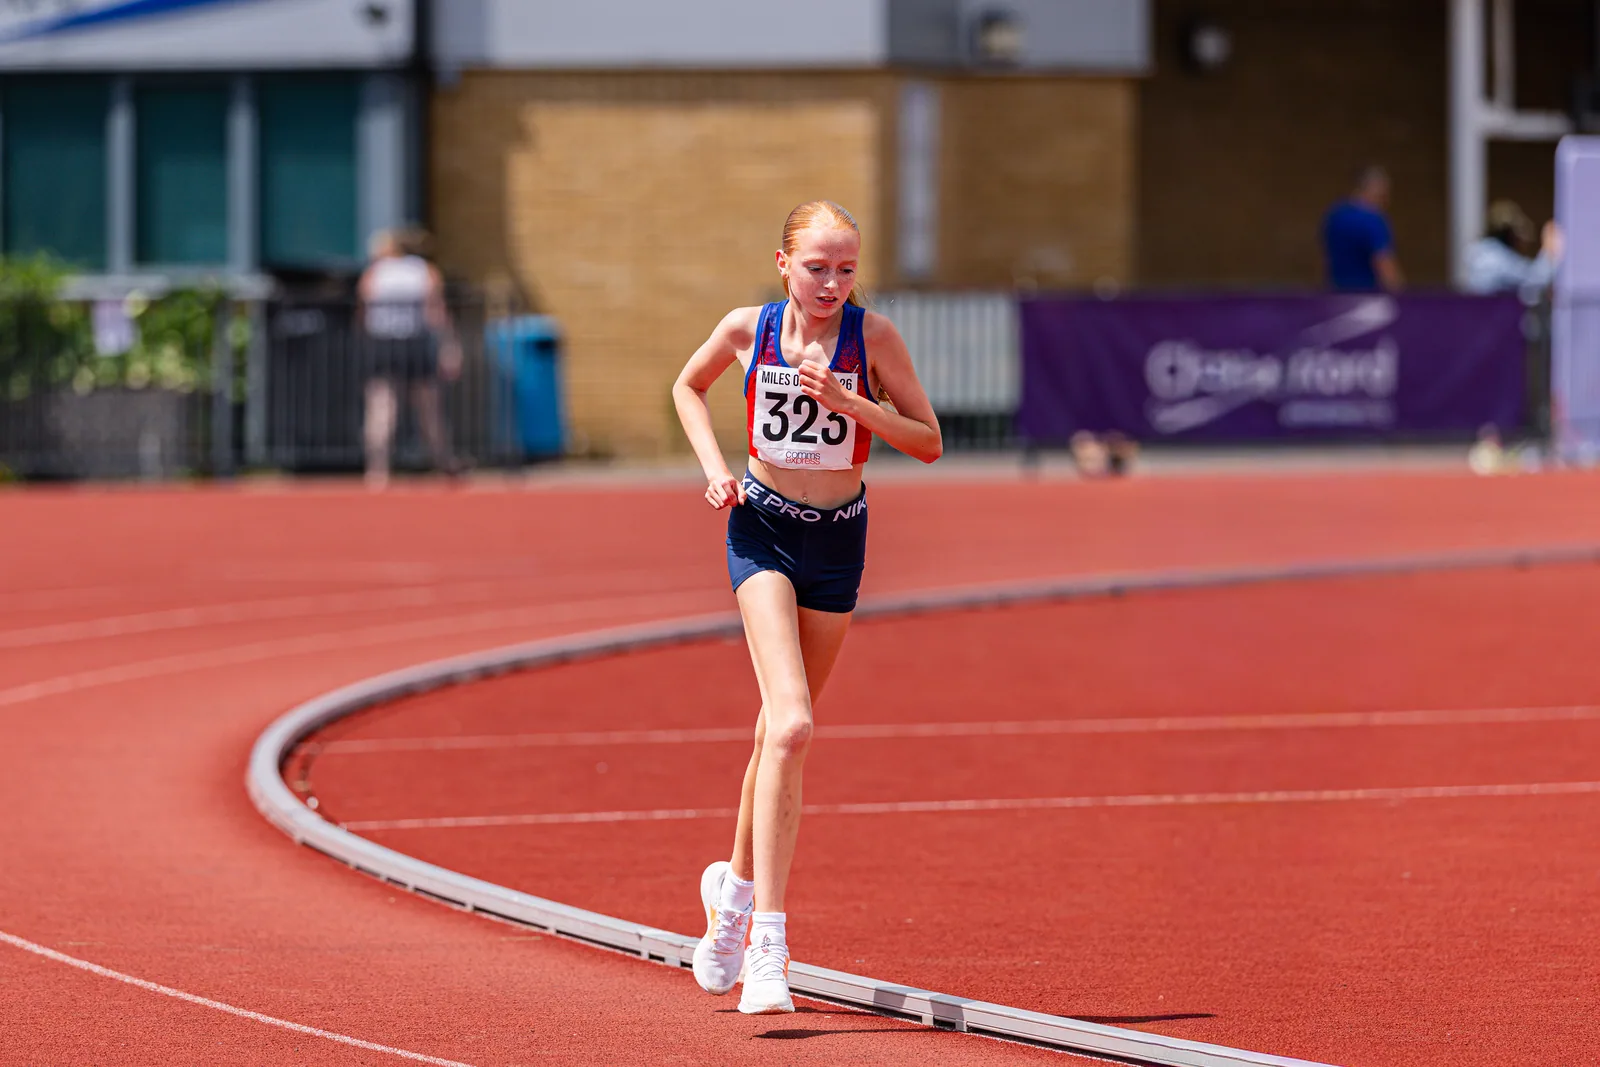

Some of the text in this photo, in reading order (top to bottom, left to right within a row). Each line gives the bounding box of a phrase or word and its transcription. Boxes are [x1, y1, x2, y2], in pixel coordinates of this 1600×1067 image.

[761, 370, 791, 386] MILES
[762, 391, 848, 446] 323
[785, 450, 821, 460] comms
[785, 457, 821, 465] express
[762, 493, 822, 522] PRO
